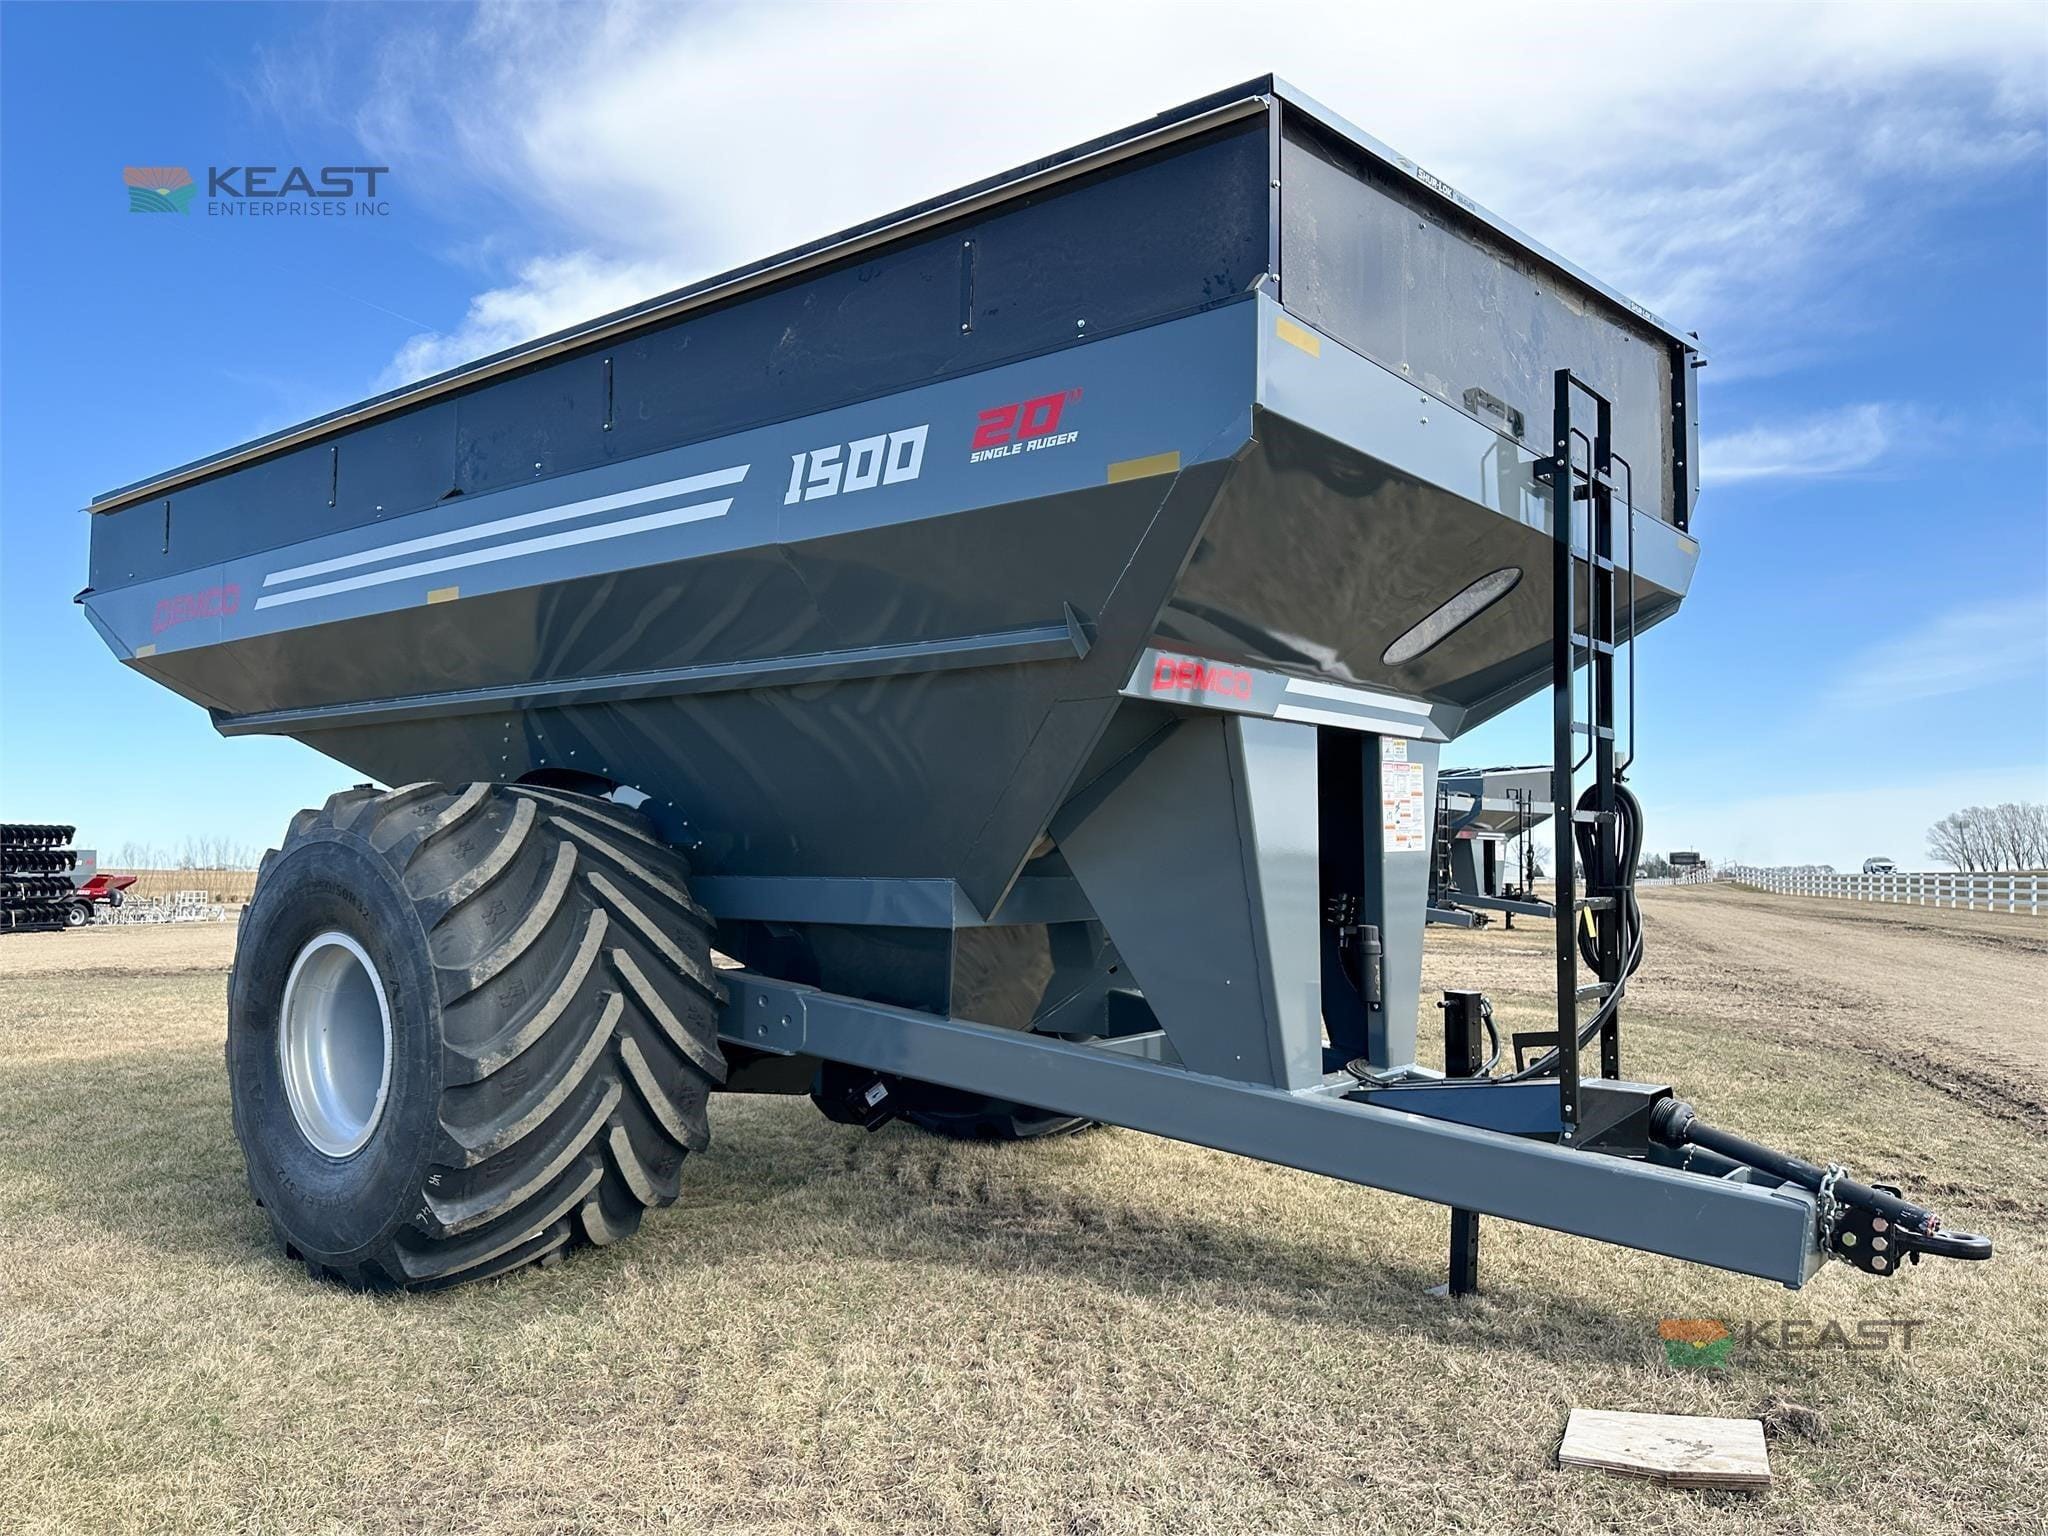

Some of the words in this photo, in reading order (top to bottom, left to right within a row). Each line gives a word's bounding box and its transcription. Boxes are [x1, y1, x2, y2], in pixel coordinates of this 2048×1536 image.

[783, 423, 929, 505] 1500
[970, 443, 1023, 464] SINGLE
[1026, 431, 1079, 452] AUGER
[152, 583, 241, 635] DEMCO
[1152, 656, 1252, 701] DEMCO
